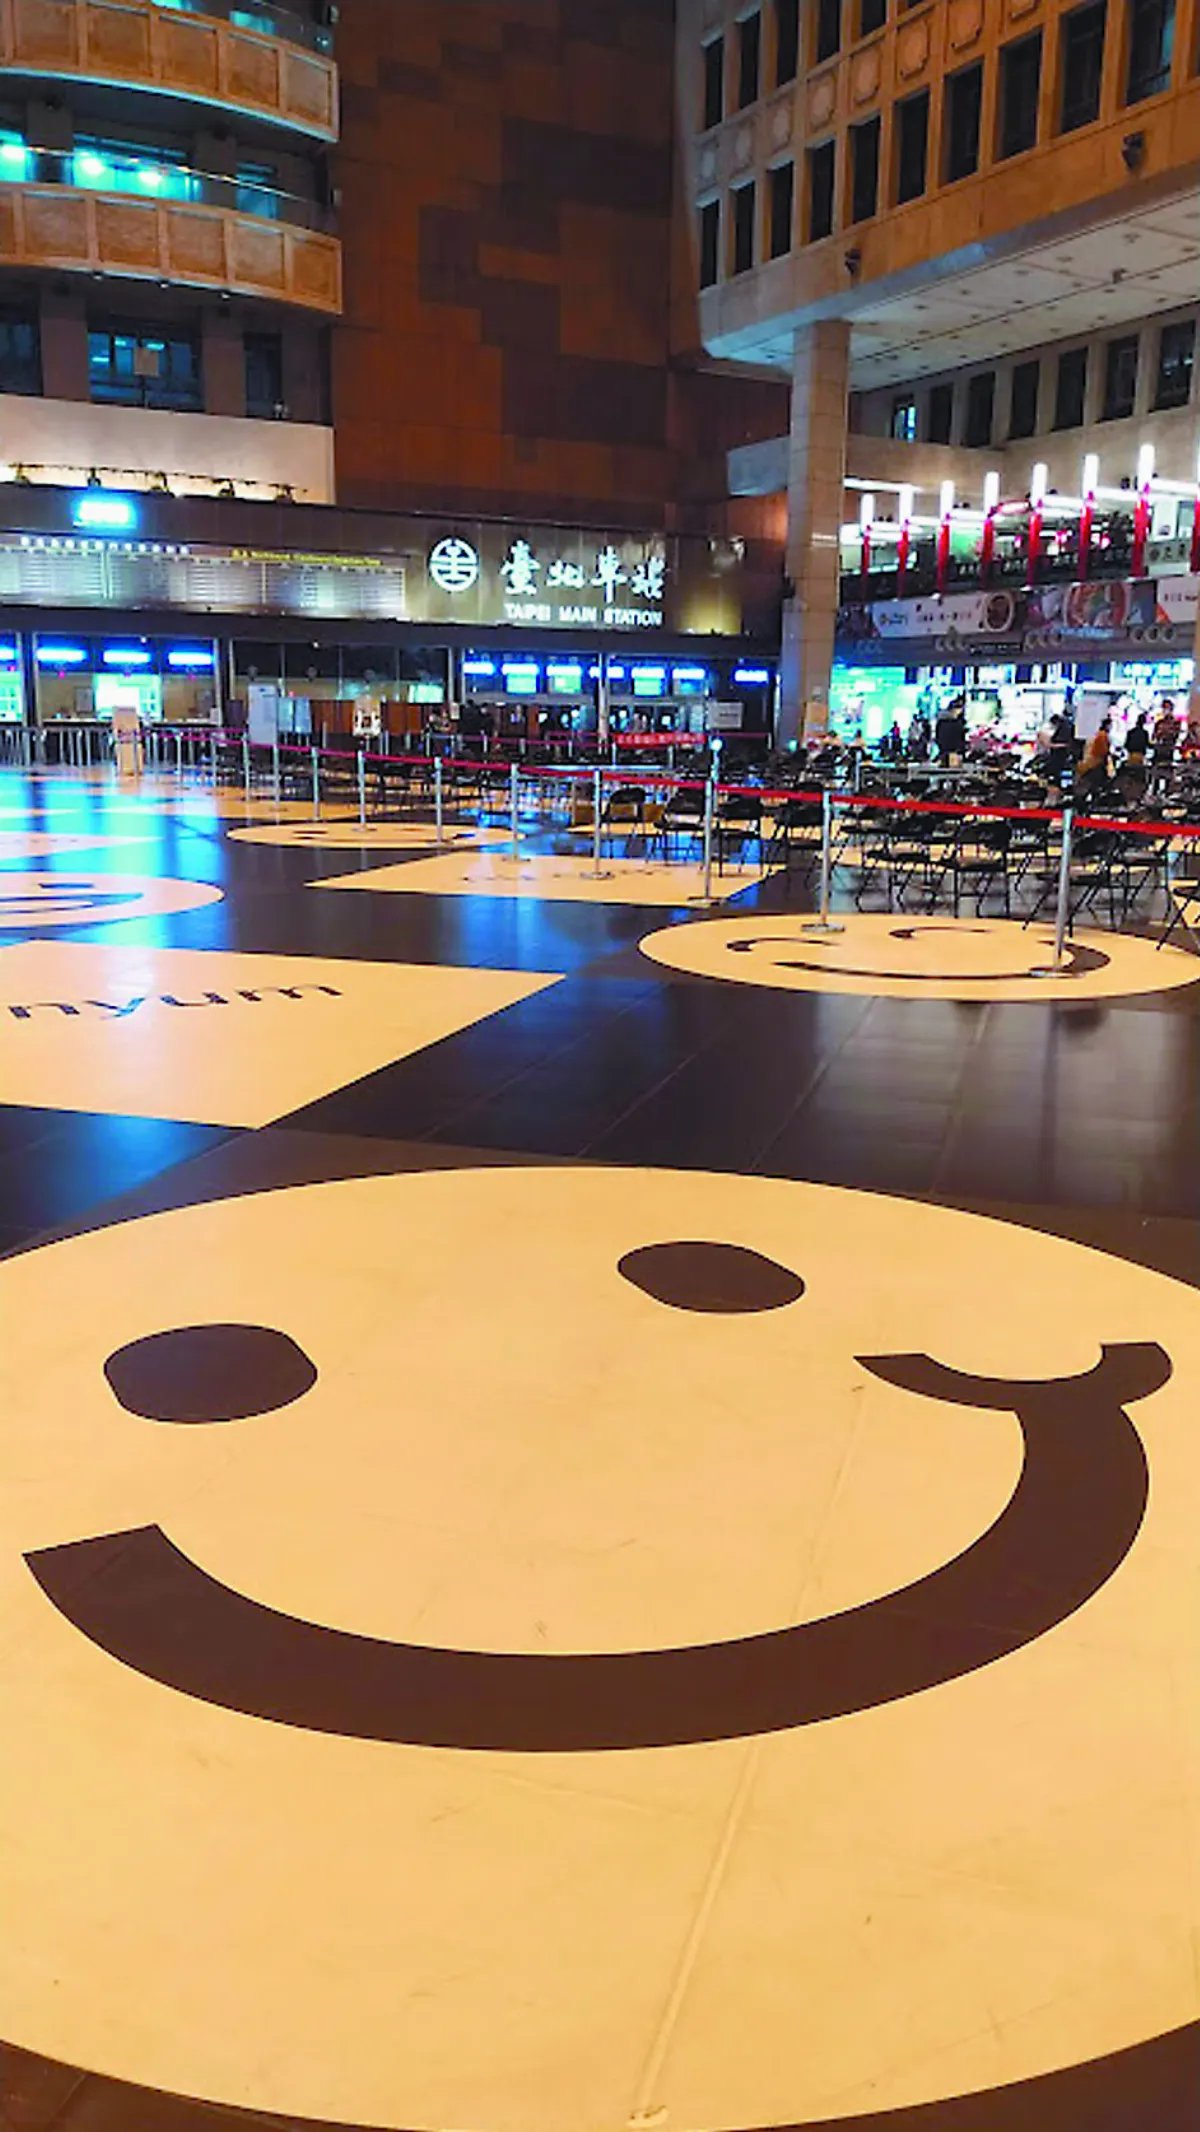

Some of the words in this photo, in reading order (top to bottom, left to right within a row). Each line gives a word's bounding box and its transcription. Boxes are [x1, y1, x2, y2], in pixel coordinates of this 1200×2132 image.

[505, 603, 550, 621] TAIPEI
[559, 605, 597, 622] MAIN
[603, 608, 662, 626] STATION
